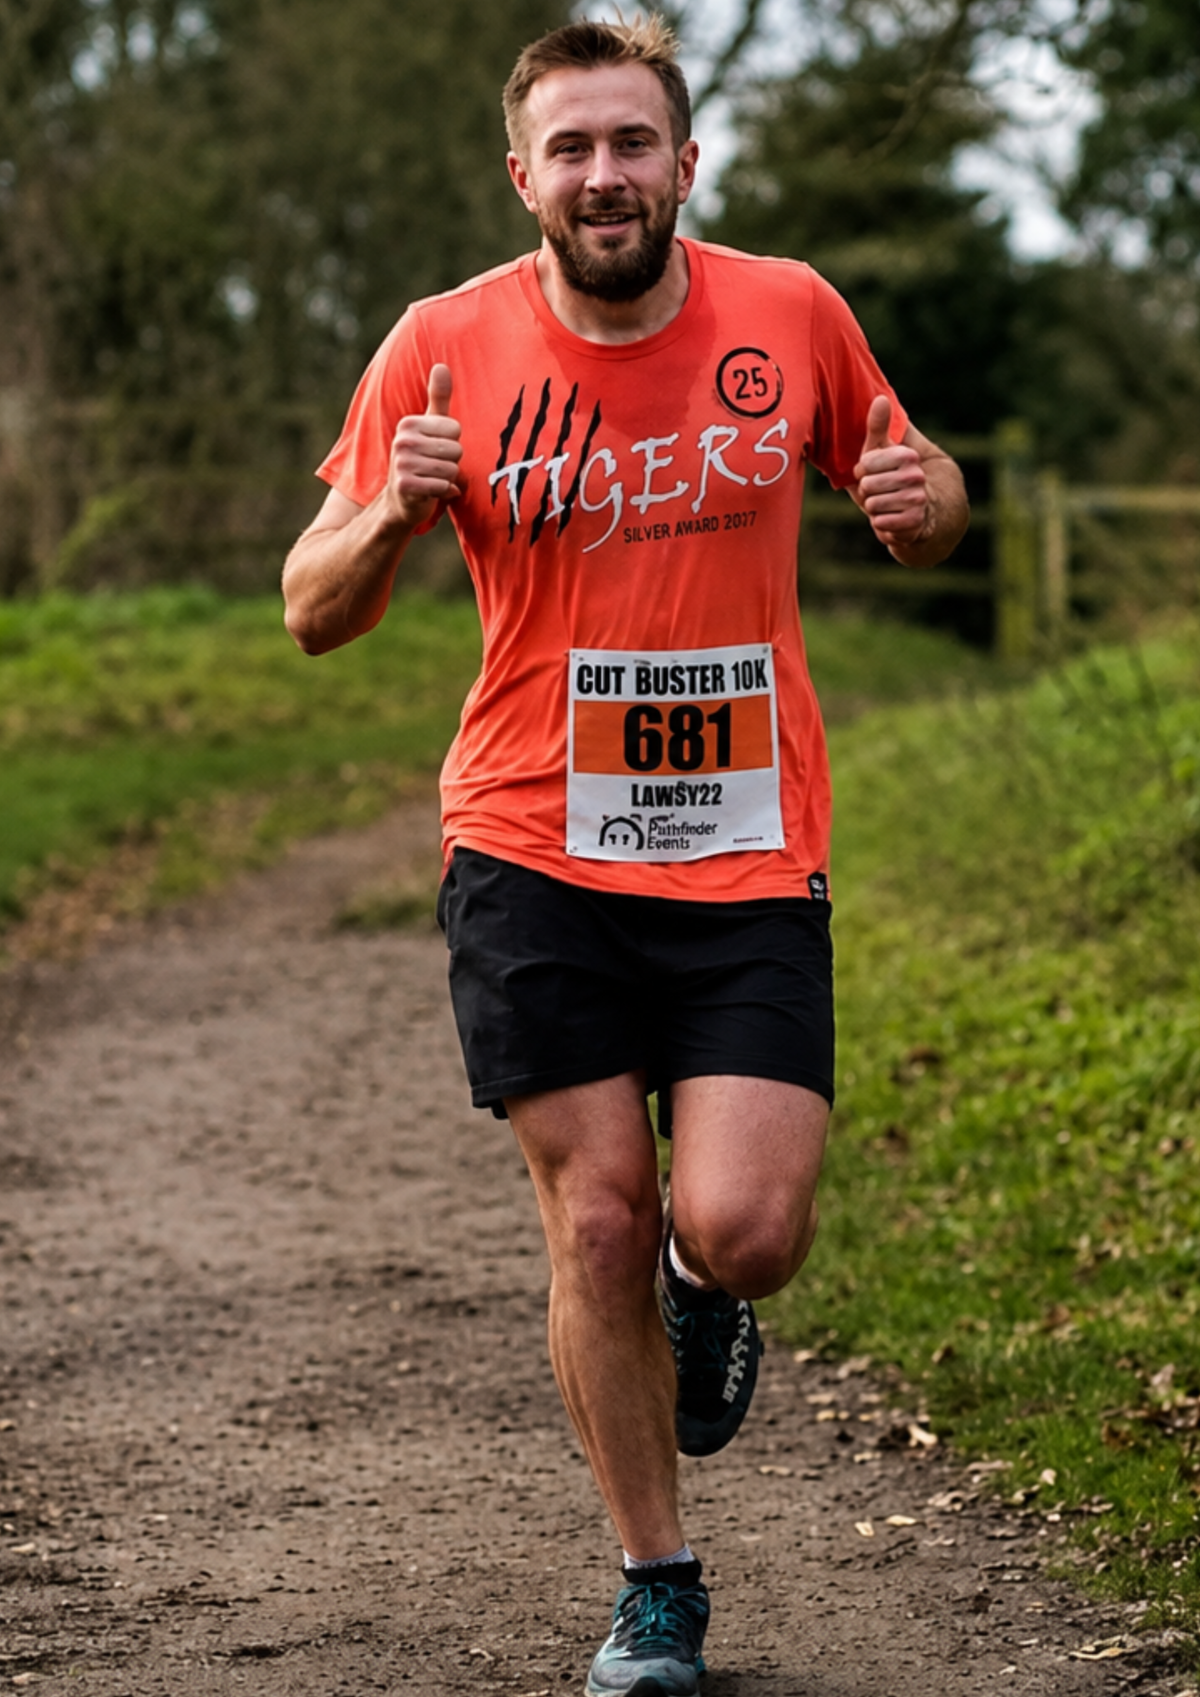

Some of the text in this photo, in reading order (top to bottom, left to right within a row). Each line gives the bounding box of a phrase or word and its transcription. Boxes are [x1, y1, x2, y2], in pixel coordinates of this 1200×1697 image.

[732, 367, 768, 400] 25
[488, 417, 790, 553] TIGERS
[623, 521, 671, 544] SILVER
[675, 515, 718, 538] AWARD
[576, 659, 768, 696] CUT BUSTER 10K
[623, 702, 731, 772] 681
[631, 782, 723, 808] LAWSY22
